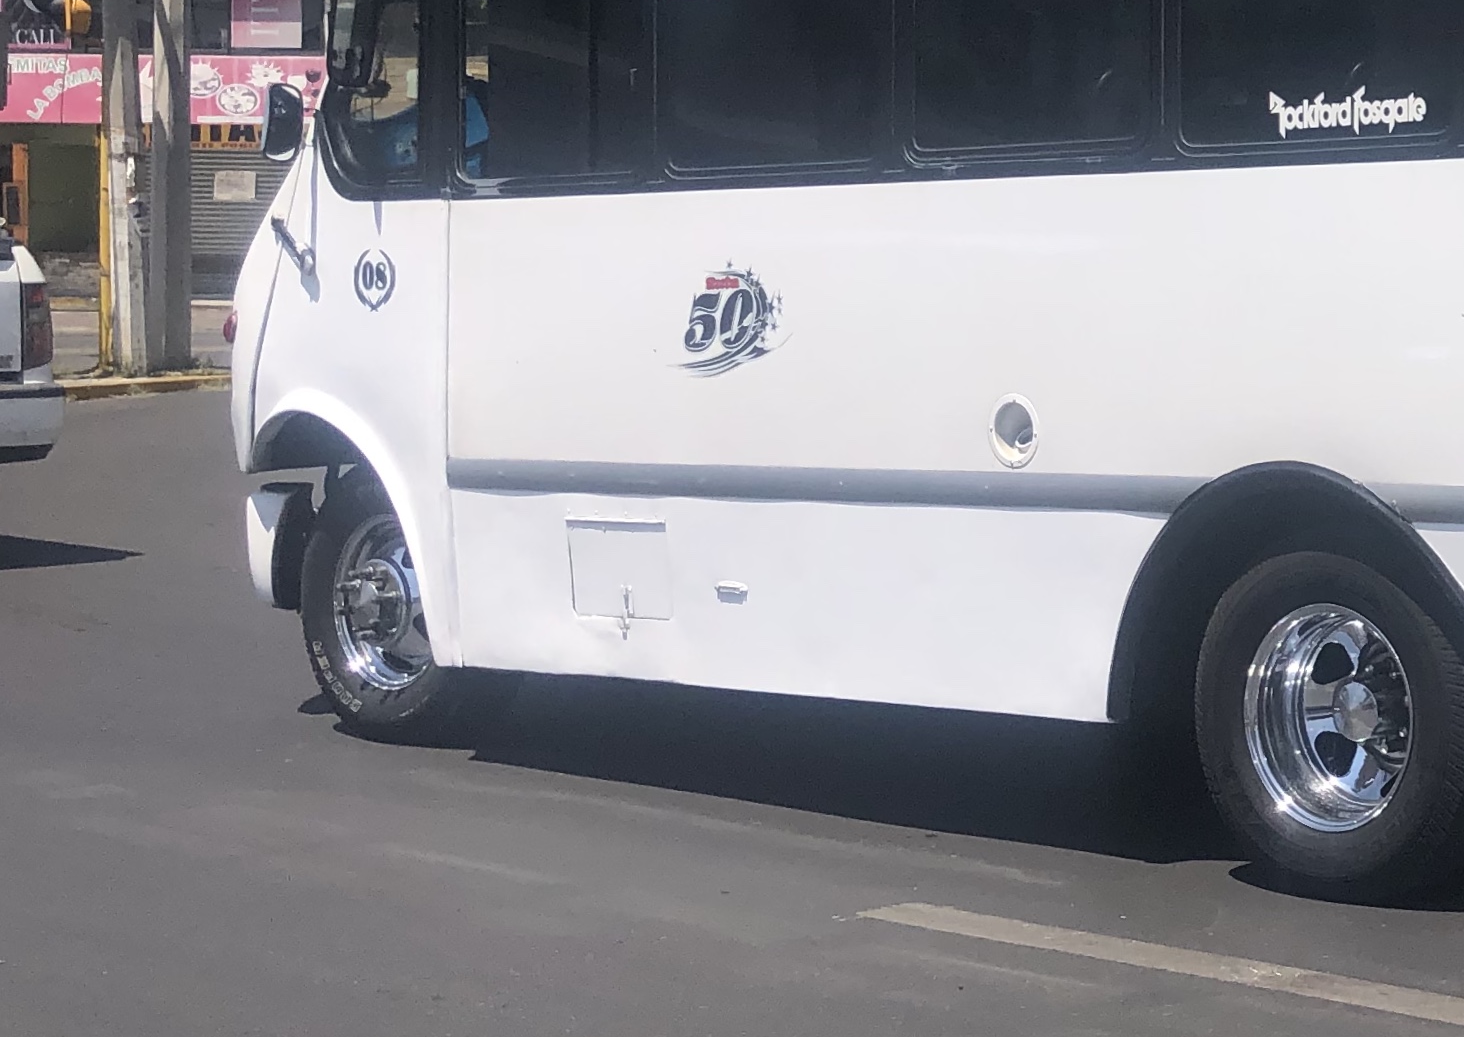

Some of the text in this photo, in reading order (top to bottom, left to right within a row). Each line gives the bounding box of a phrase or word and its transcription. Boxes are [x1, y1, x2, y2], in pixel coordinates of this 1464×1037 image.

[27, 98, 50, 120] LA
[1268, 91, 1352, 140] Rockford
[361, 260, 388, 291] 08
[684, 288, 755, 353] 50
